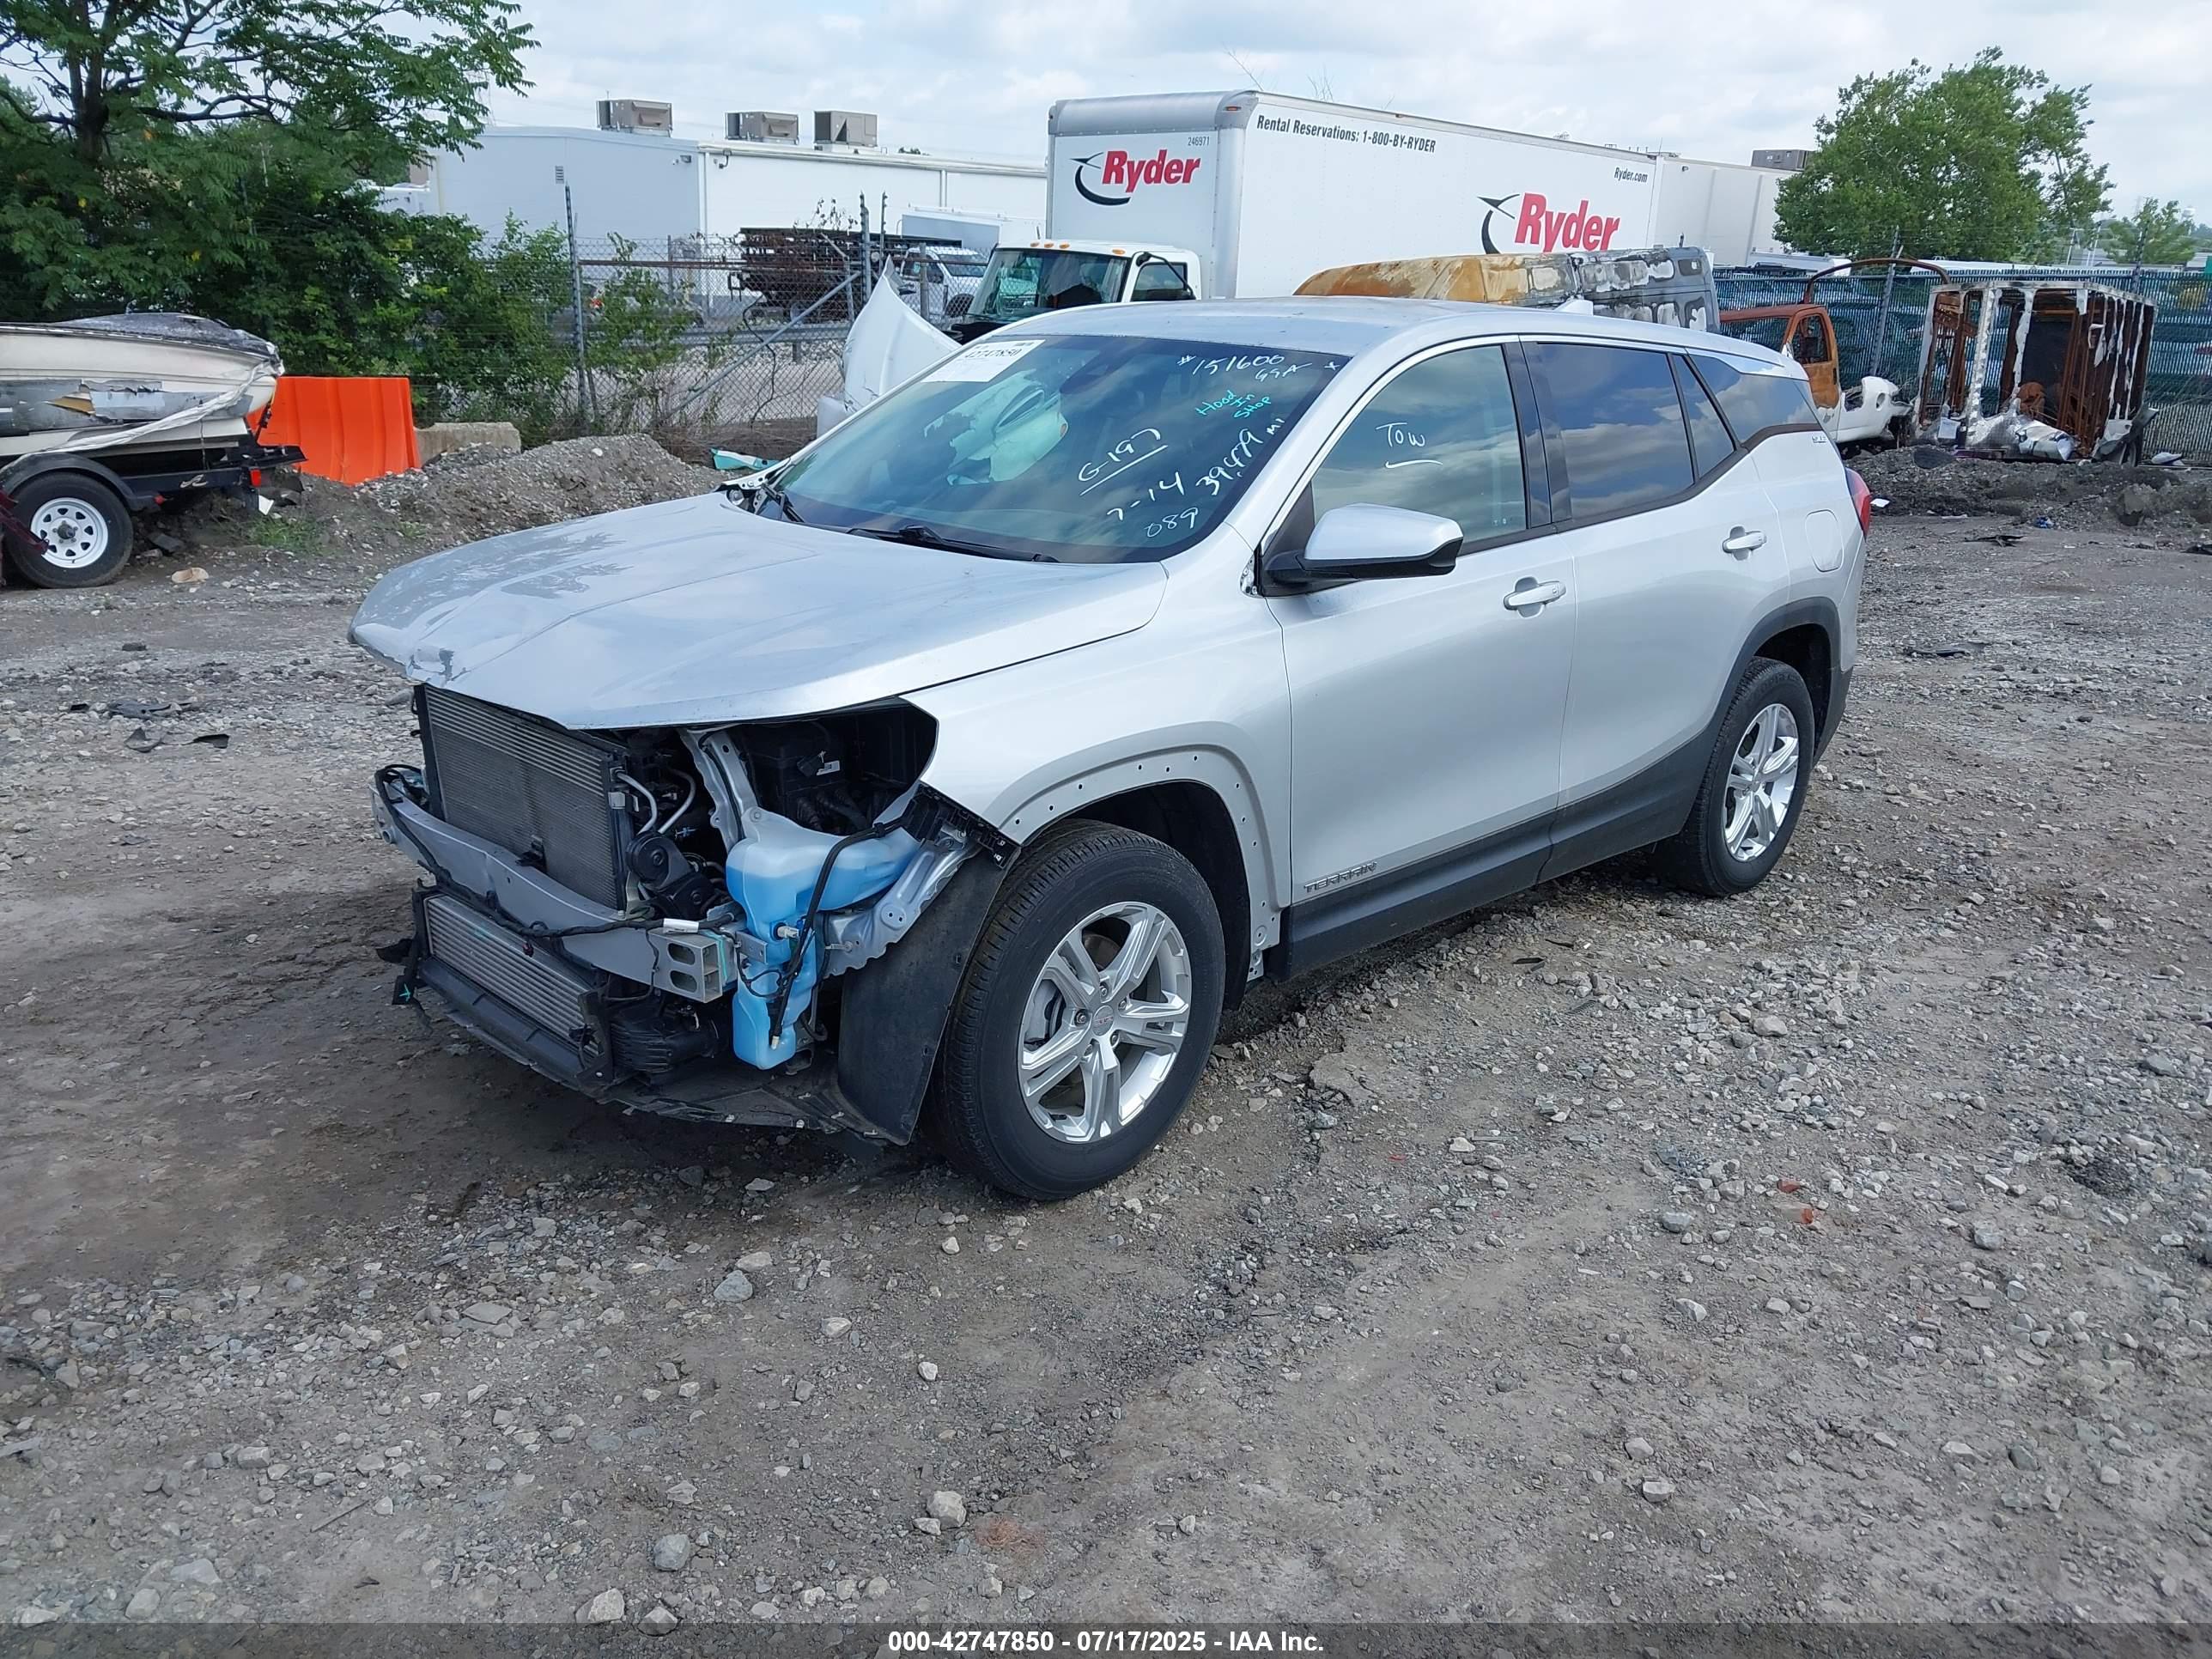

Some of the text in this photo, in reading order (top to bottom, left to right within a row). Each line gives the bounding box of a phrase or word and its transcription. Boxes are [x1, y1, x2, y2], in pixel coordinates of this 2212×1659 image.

[1188, 137, 1211, 147] 246971
[1256, 114, 1437, 154] Rental Reservations: 1-800-BY-RYDER
[1102, 149, 1201, 193] Ryder
[1613, 167, 1649, 183] Ryder.com
[1514, 191, 1621, 253] Ryder
